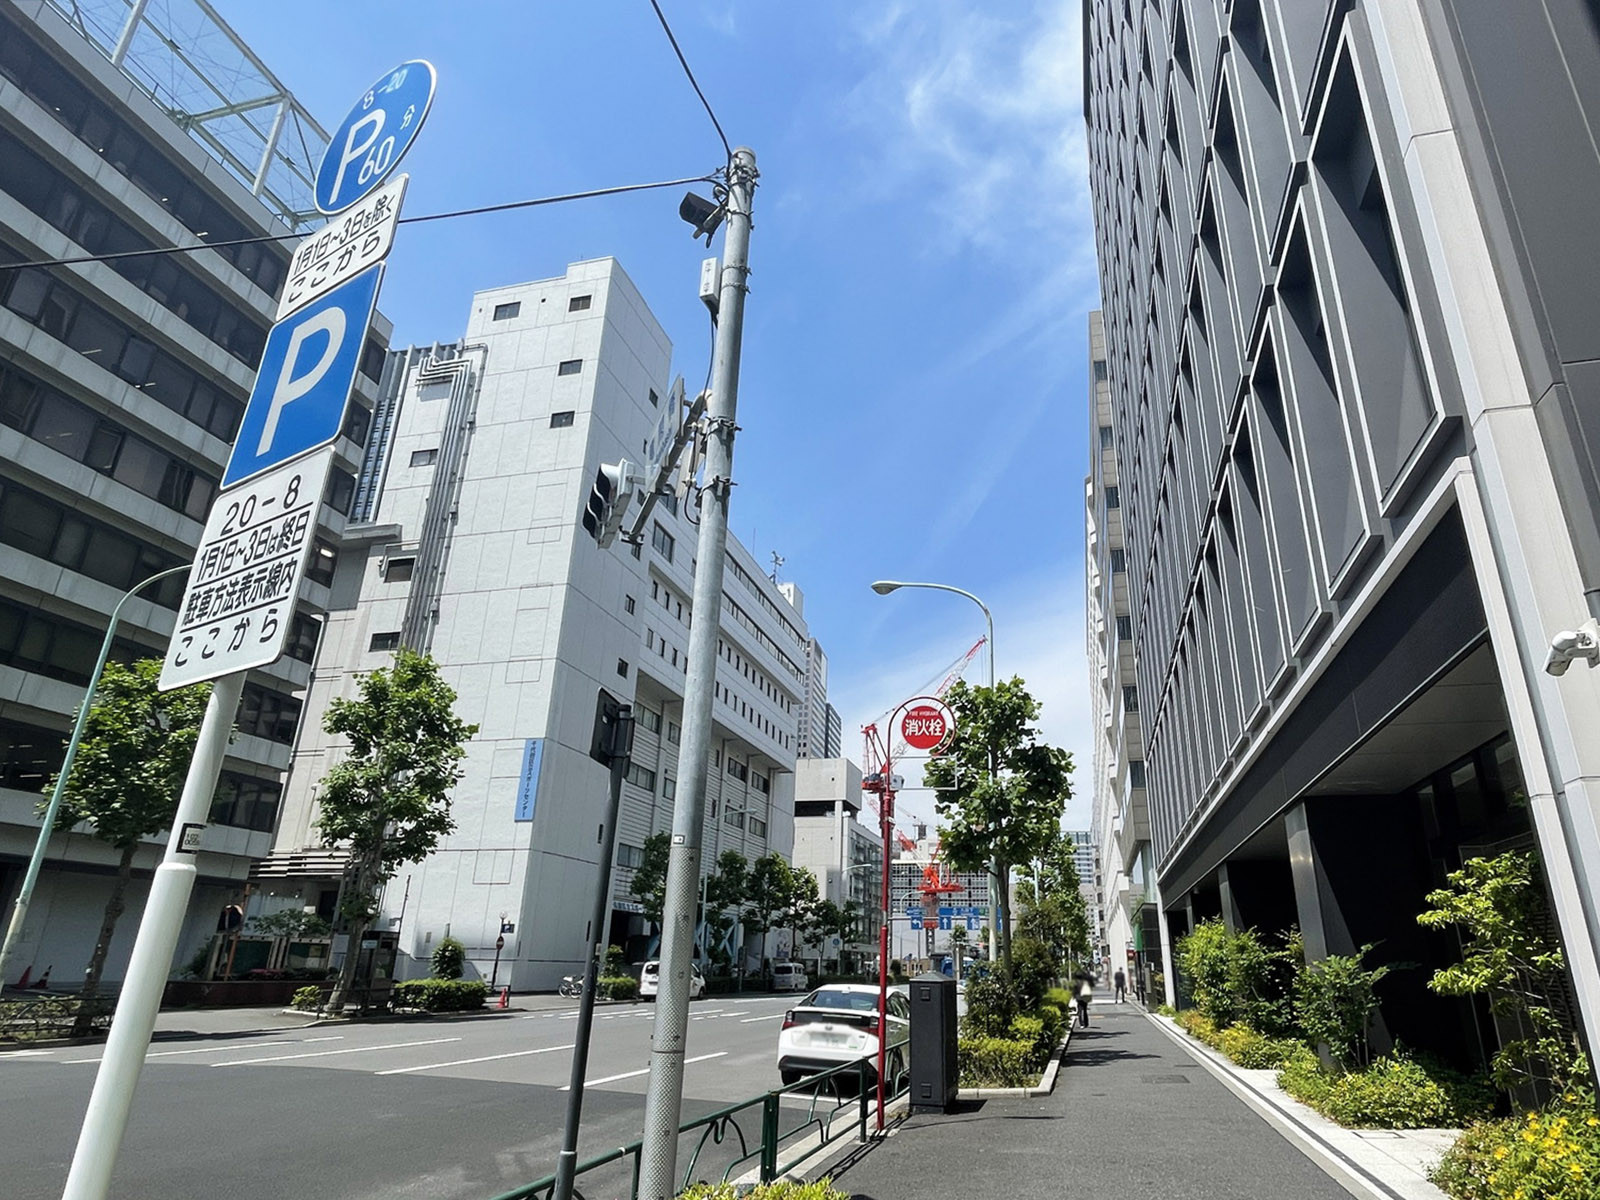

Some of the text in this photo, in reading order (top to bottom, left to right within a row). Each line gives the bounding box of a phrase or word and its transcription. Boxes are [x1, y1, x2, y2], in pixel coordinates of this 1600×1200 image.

[328, 109, 386, 206] P
[288, 230, 380, 303] ここから
[256, 307, 346, 457] P
[182, 557, 298, 627] 駐車方法表示線内
[174, 608, 279, 667] ここから
[905, 719, 943, 736] 消火栓
